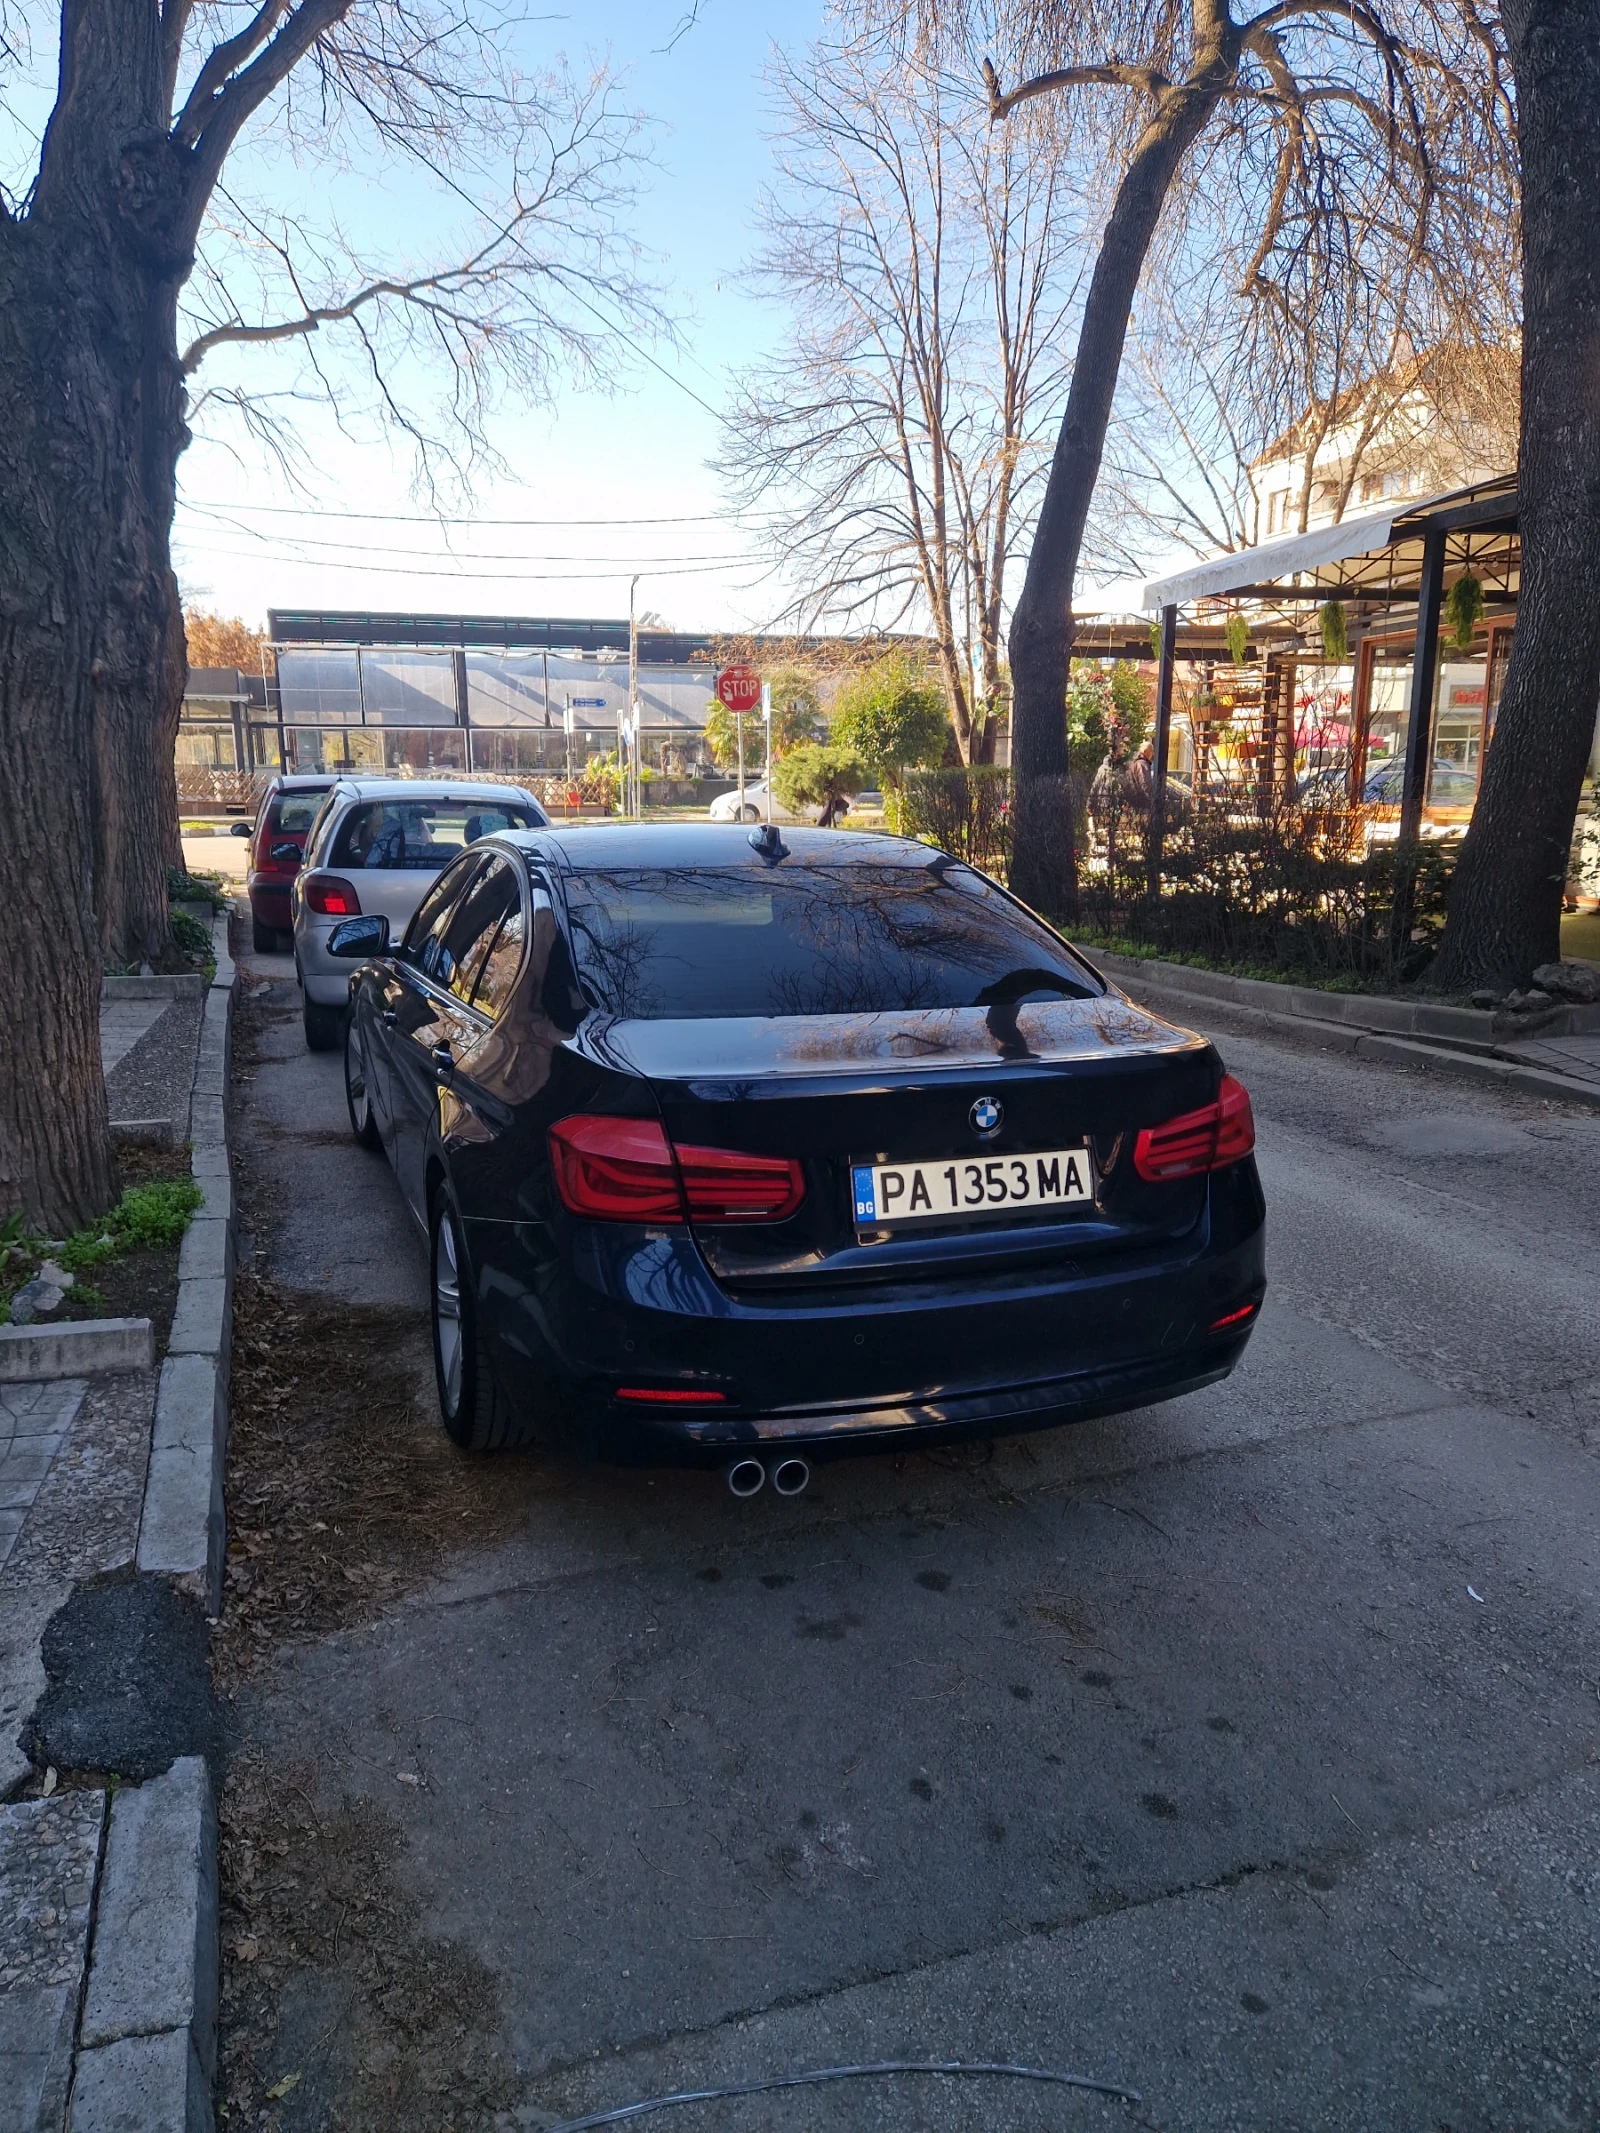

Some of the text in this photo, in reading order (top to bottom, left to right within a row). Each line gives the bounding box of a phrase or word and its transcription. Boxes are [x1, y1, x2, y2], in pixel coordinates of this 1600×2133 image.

[722, 680, 757, 698] STOP
[973, 1098, 1003, 1111] BMW
[880, 1156, 1085, 1213] PA 1353 MA
[857, 1201, 874, 1214] BG
